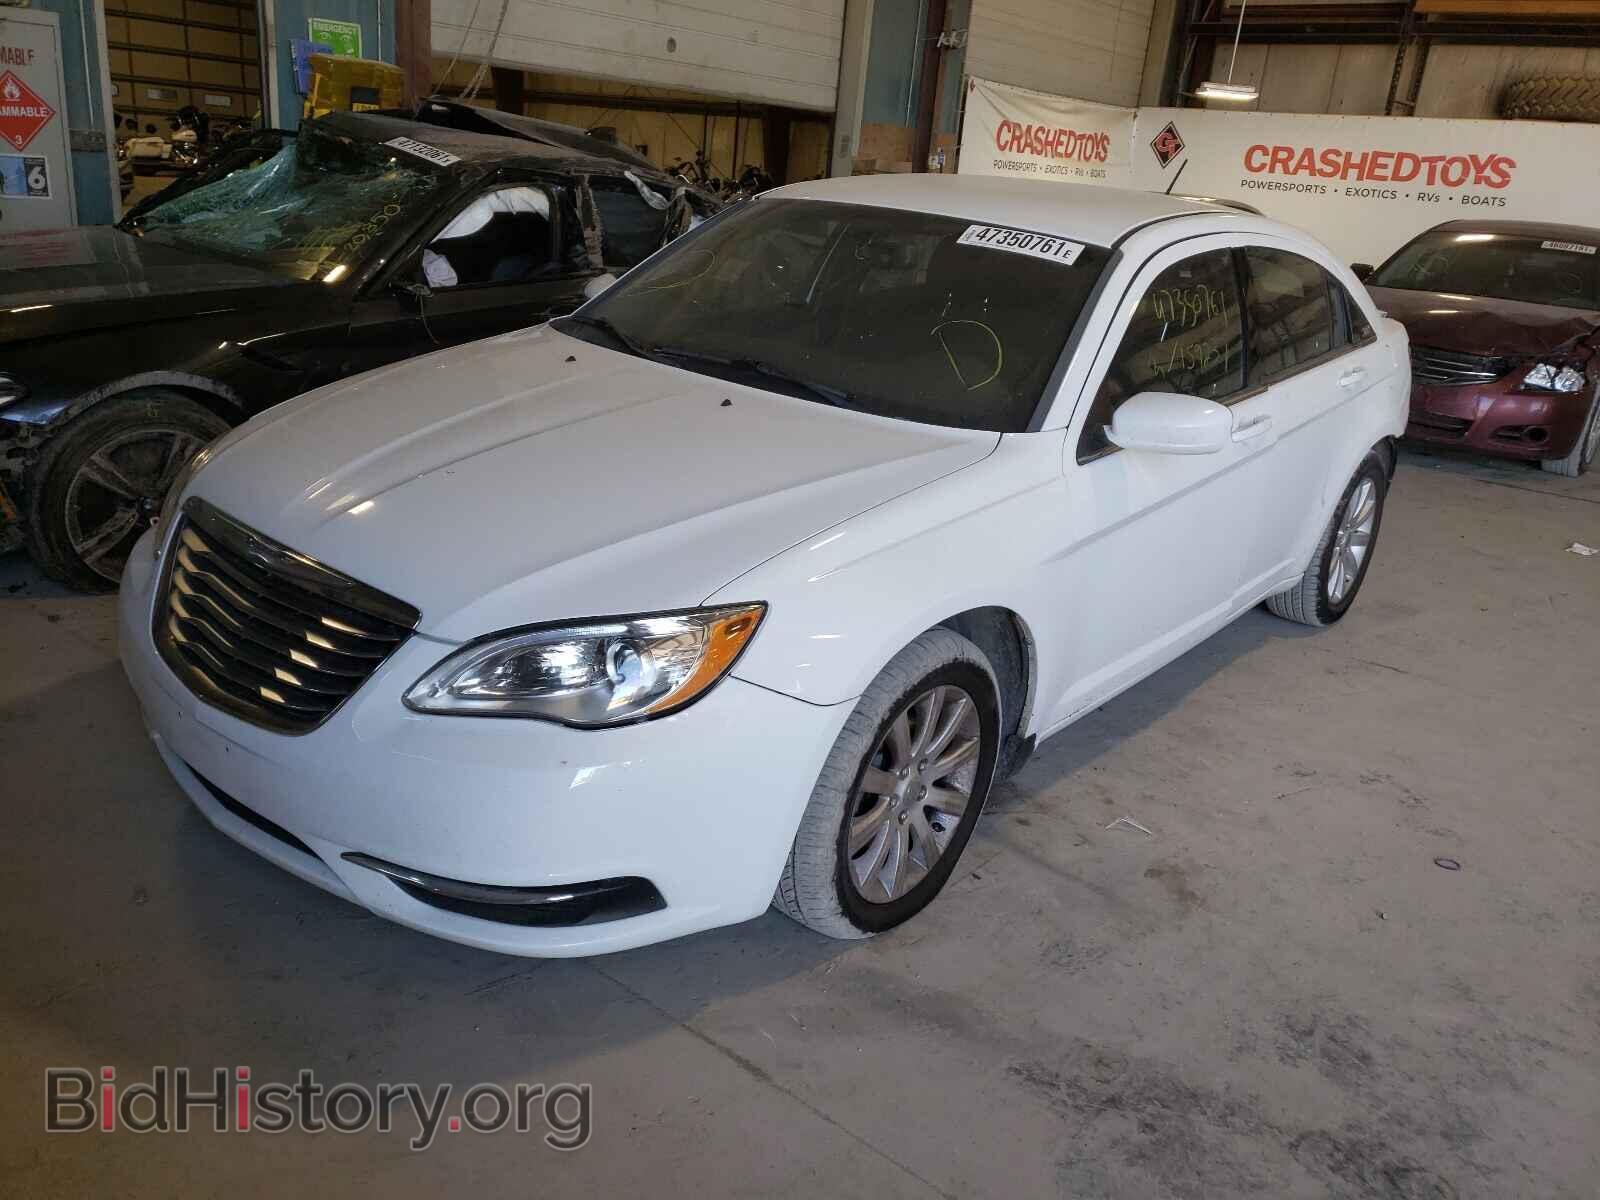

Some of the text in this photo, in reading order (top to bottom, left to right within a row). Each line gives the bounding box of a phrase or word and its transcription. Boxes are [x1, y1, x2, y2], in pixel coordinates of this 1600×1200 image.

[15, 134, 23, 145] 3
[995, 119, 1110, 163] CRASHEDTOYS
[27, 165, 46, 190] 6
[993, 159, 1038, 173] POWERSPORTS
[1044, 164, 1069, 176] EXOTICS
[1243, 144, 1517, 189] CRASHEDTOYS
[1240, 179, 1507, 208] POWERSPORTS EXOTICS RVs BOATS
[975, 227, 1067, 257] 47350761
